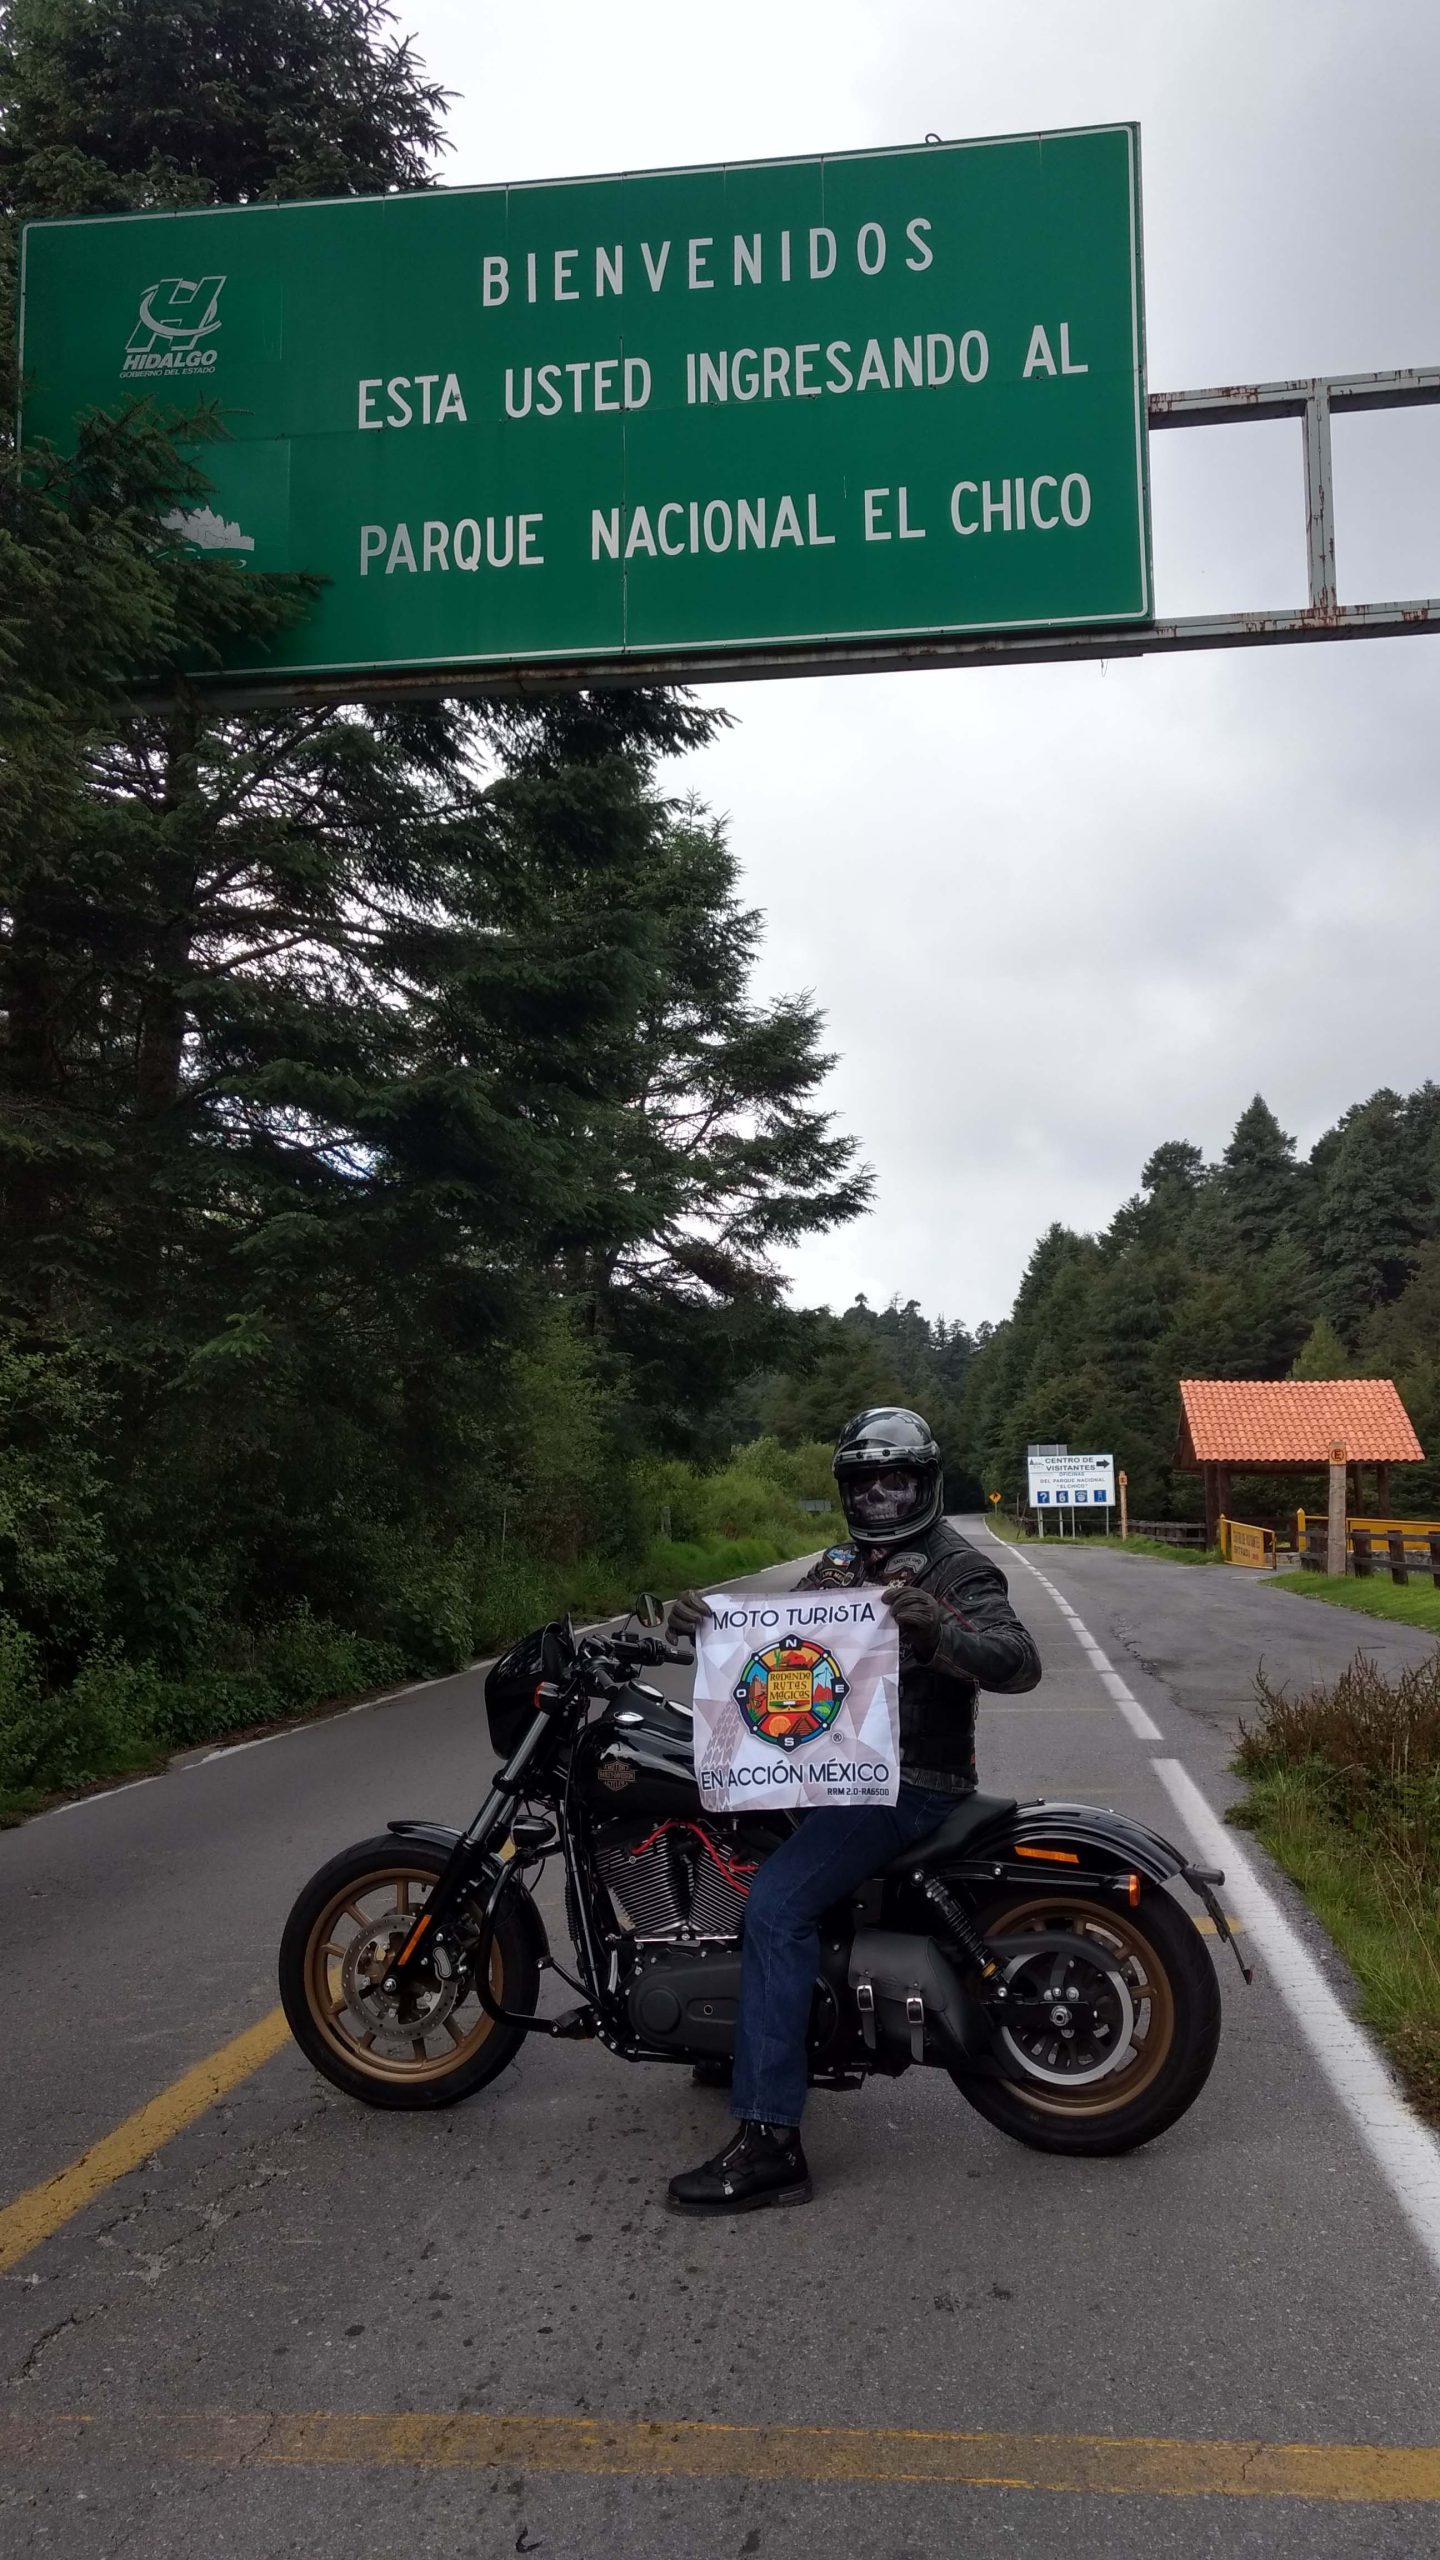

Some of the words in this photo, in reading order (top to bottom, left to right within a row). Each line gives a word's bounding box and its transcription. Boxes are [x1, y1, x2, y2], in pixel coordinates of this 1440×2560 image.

[483, 218, 934, 307] BIENVENIDOS
[120, 369, 162, 379] GOBIERNO
[164, 368, 180, 376] DEL
[182, 366, 216, 375] ESTADO
[123, 350, 218, 371] HIDALGO
[359, 374, 468, 430] ESTA
[505, 358, 651, 419] USTED
[687, 330, 989, 404] INGRESANDO
[1023, 322, 1088, 379] AL
[360, 513, 545, 576] PARQUE
[591, 494, 835, 561] NACIONAL
[864, 487, 926, 541] EL
[950, 473, 1092, 537] CHICO
[713, 1609, 779, 1631] MOTO
[787, 1602, 876, 1626] TURISTA
[785, 1638, 798, 1648] N
[834, 1684, 845, 1693] E
[783, 1737, 795, 1746] S
[702, 1769, 724, 1791] EN
[727, 1759, 804, 1787] ACCIÓN
[809, 1758, 890, 1783] MÉXICO
